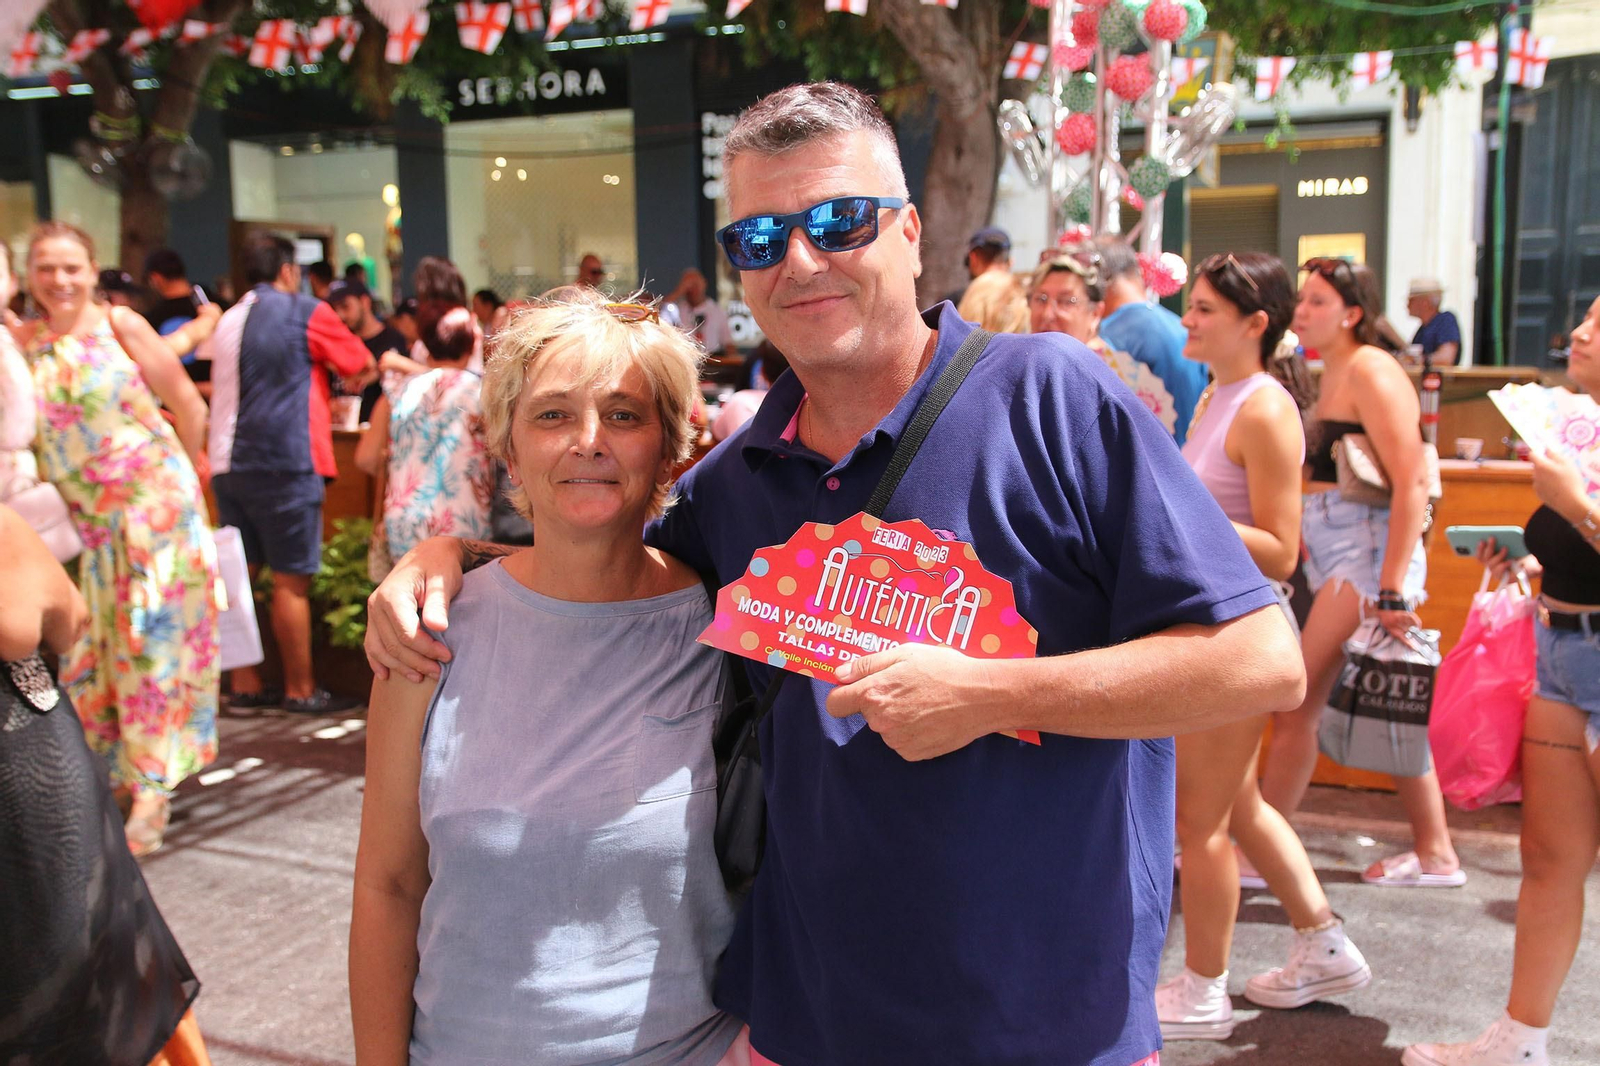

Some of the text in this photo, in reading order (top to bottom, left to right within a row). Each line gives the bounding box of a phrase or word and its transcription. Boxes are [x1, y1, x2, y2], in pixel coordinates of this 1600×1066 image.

[1297, 176, 1368, 197] MIRAS
[872, 527, 949, 563] FERIA 2023
[737, 595, 780, 623] MODA
[784, 609, 795, 626] Y
[813, 546, 982, 650] AUTÉNTICA
[764, 646, 777, 657] C/
[778, 649, 802, 663] Valle
[778, 631, 836, 657] TALLAS
